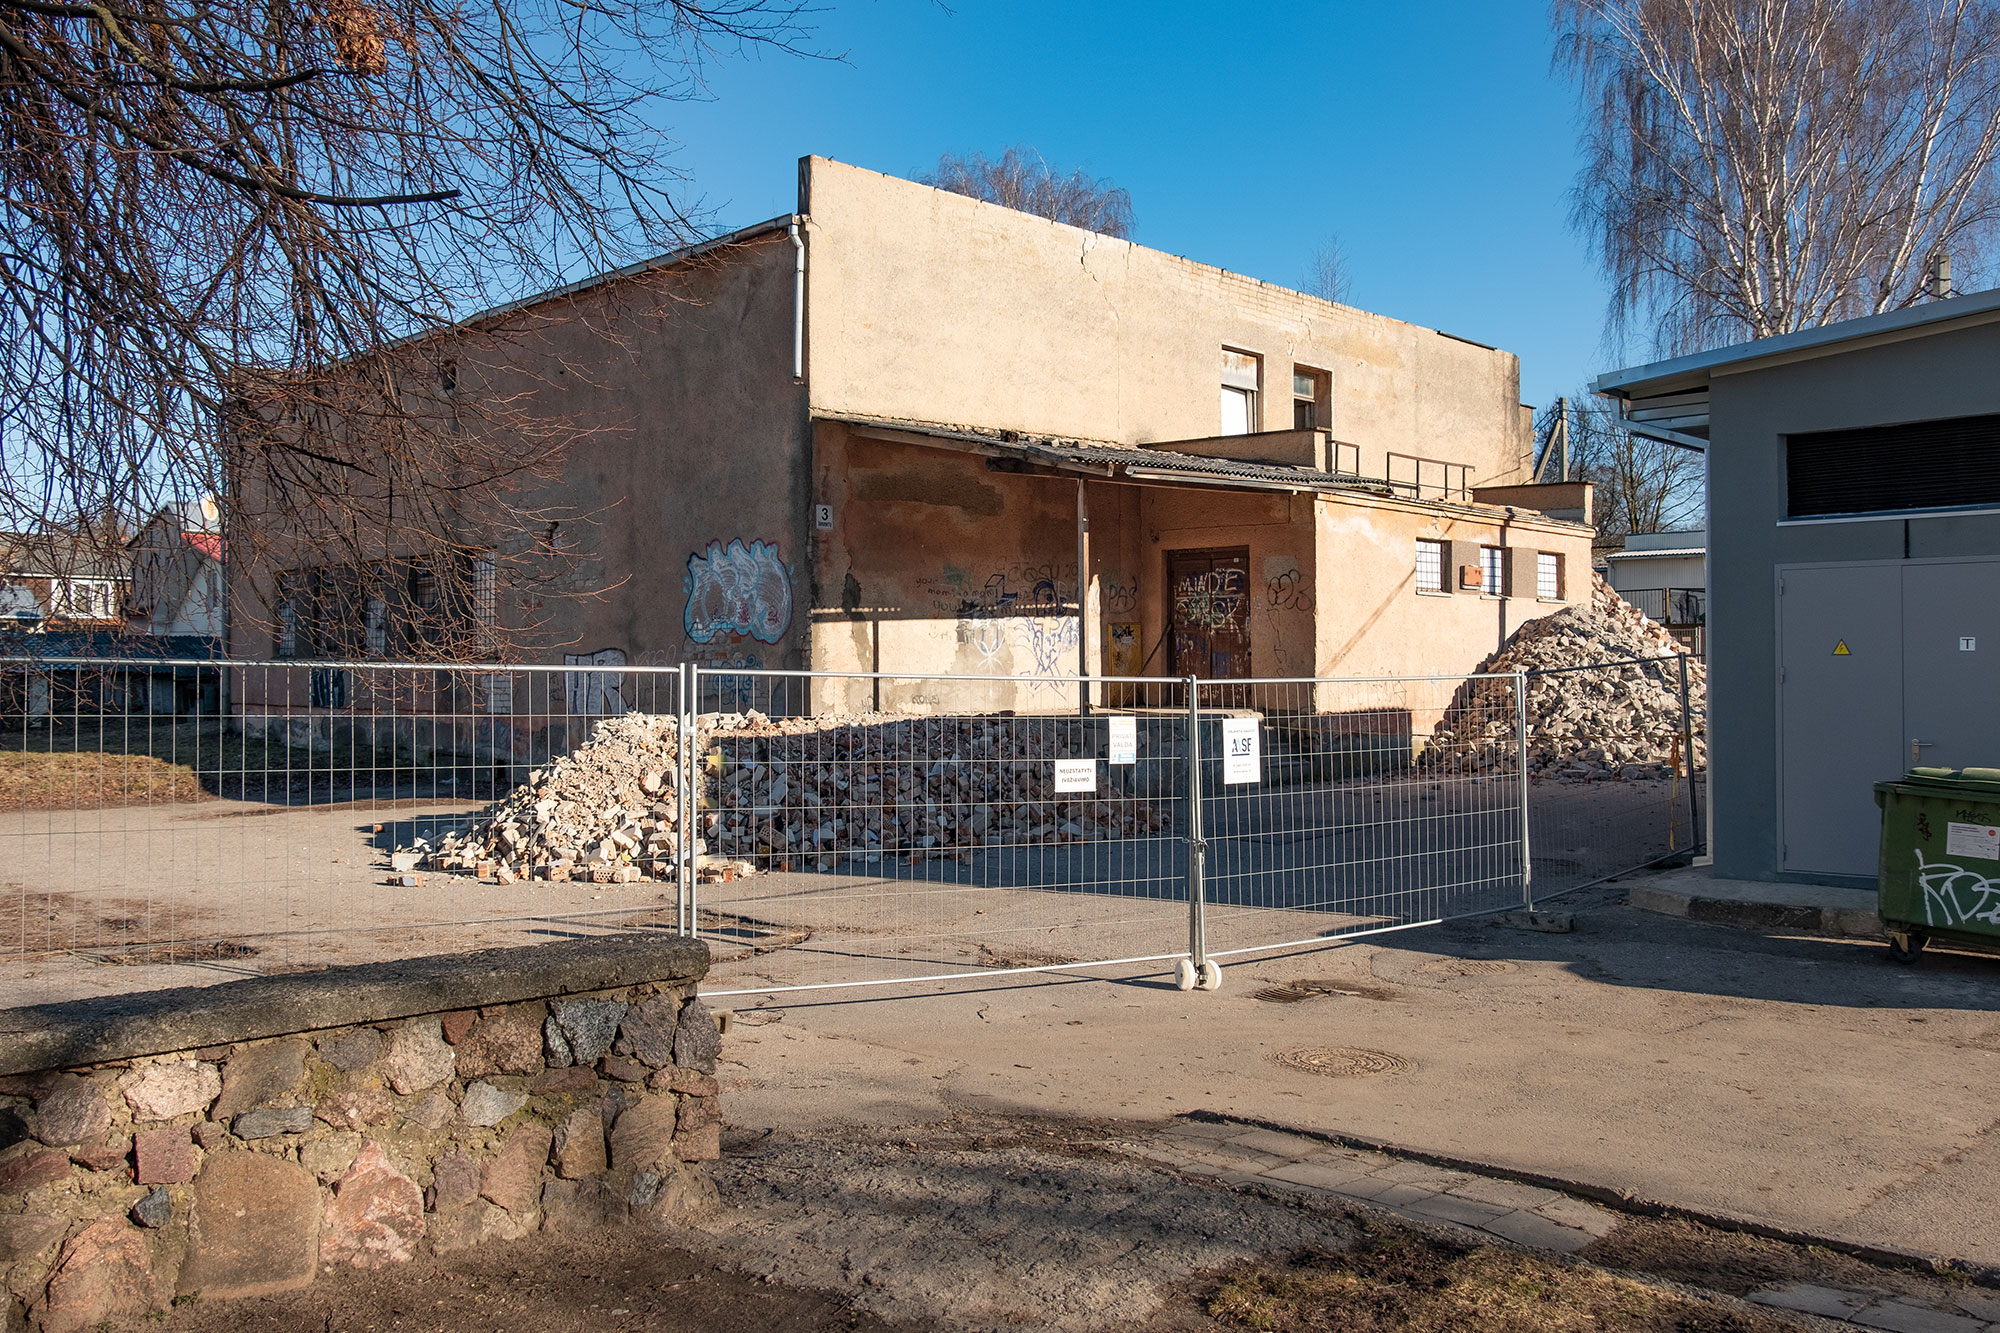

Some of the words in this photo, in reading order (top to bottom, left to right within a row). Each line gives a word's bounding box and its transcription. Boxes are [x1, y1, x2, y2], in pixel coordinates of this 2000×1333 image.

[821, 507, 829, 521] 3
[1961, 638, 1974, 650] T
[1112, 741, 1134, 749] VALDA
